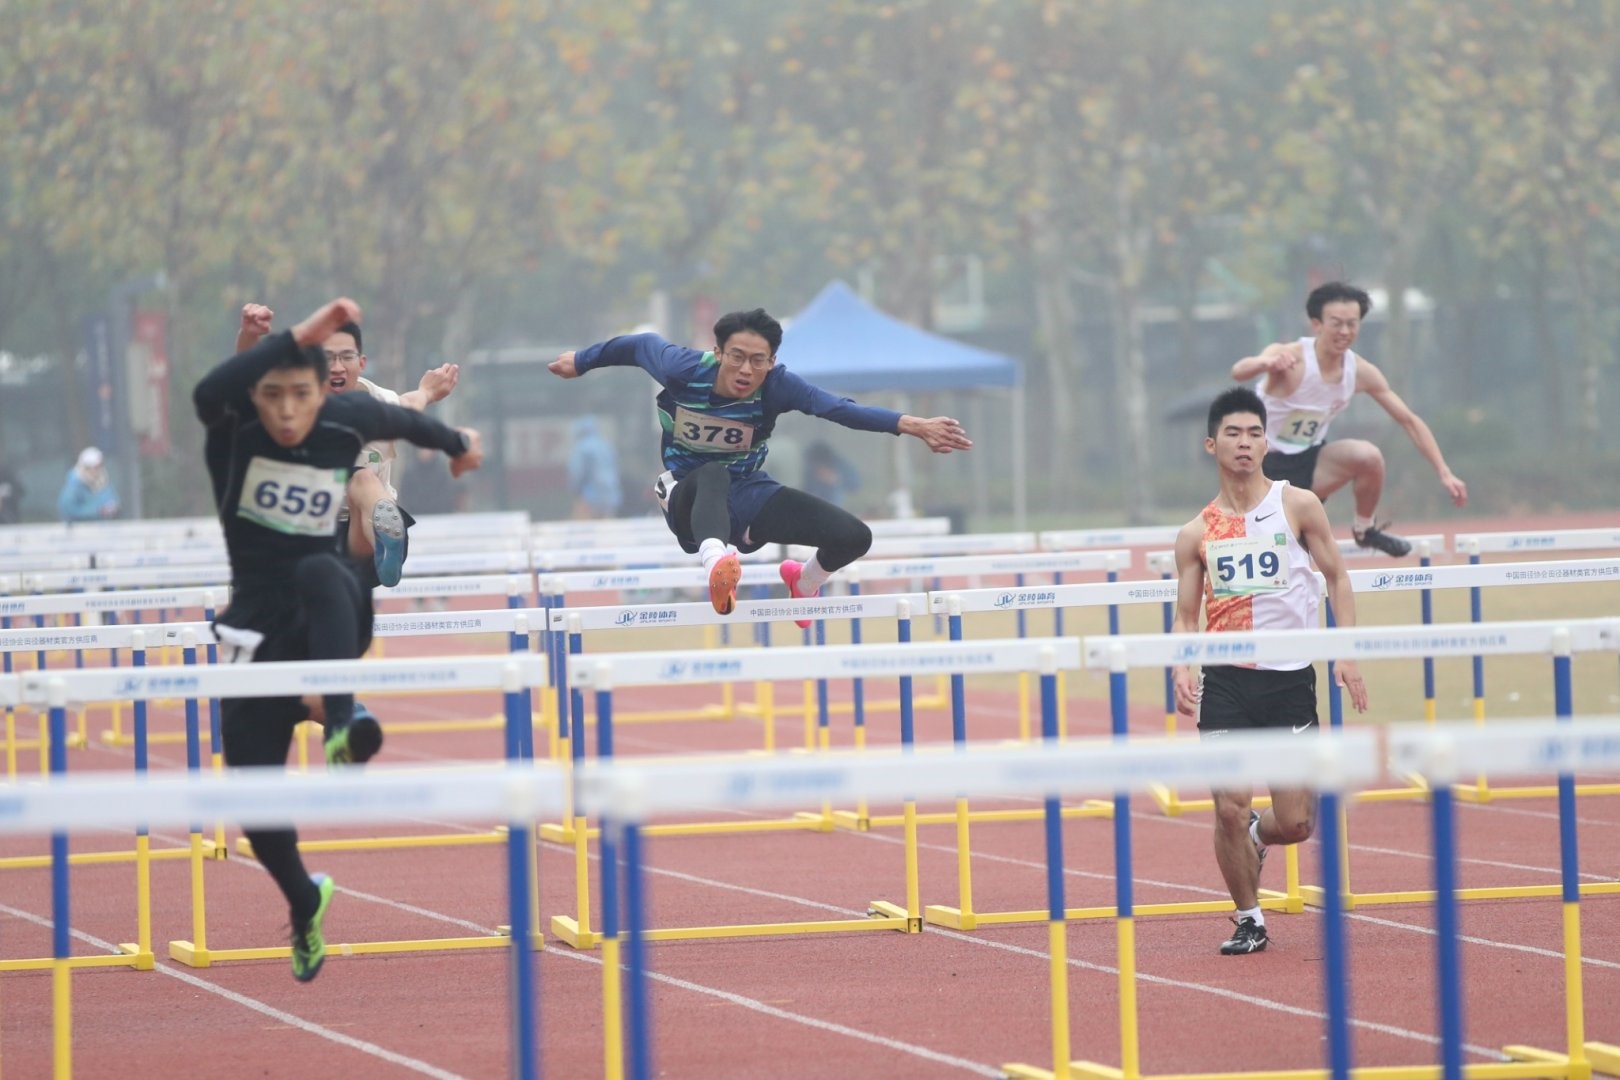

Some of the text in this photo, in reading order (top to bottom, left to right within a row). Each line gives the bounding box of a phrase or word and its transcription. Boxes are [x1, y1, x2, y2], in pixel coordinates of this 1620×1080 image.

[683, 421, 744, 445] 378
[1291, 419, 1319, 438] 13
[254, 480, 332, 518] 659
[1216, 551, 1280, 582] 519
[639, 611, 677, 620] 金陵体育
